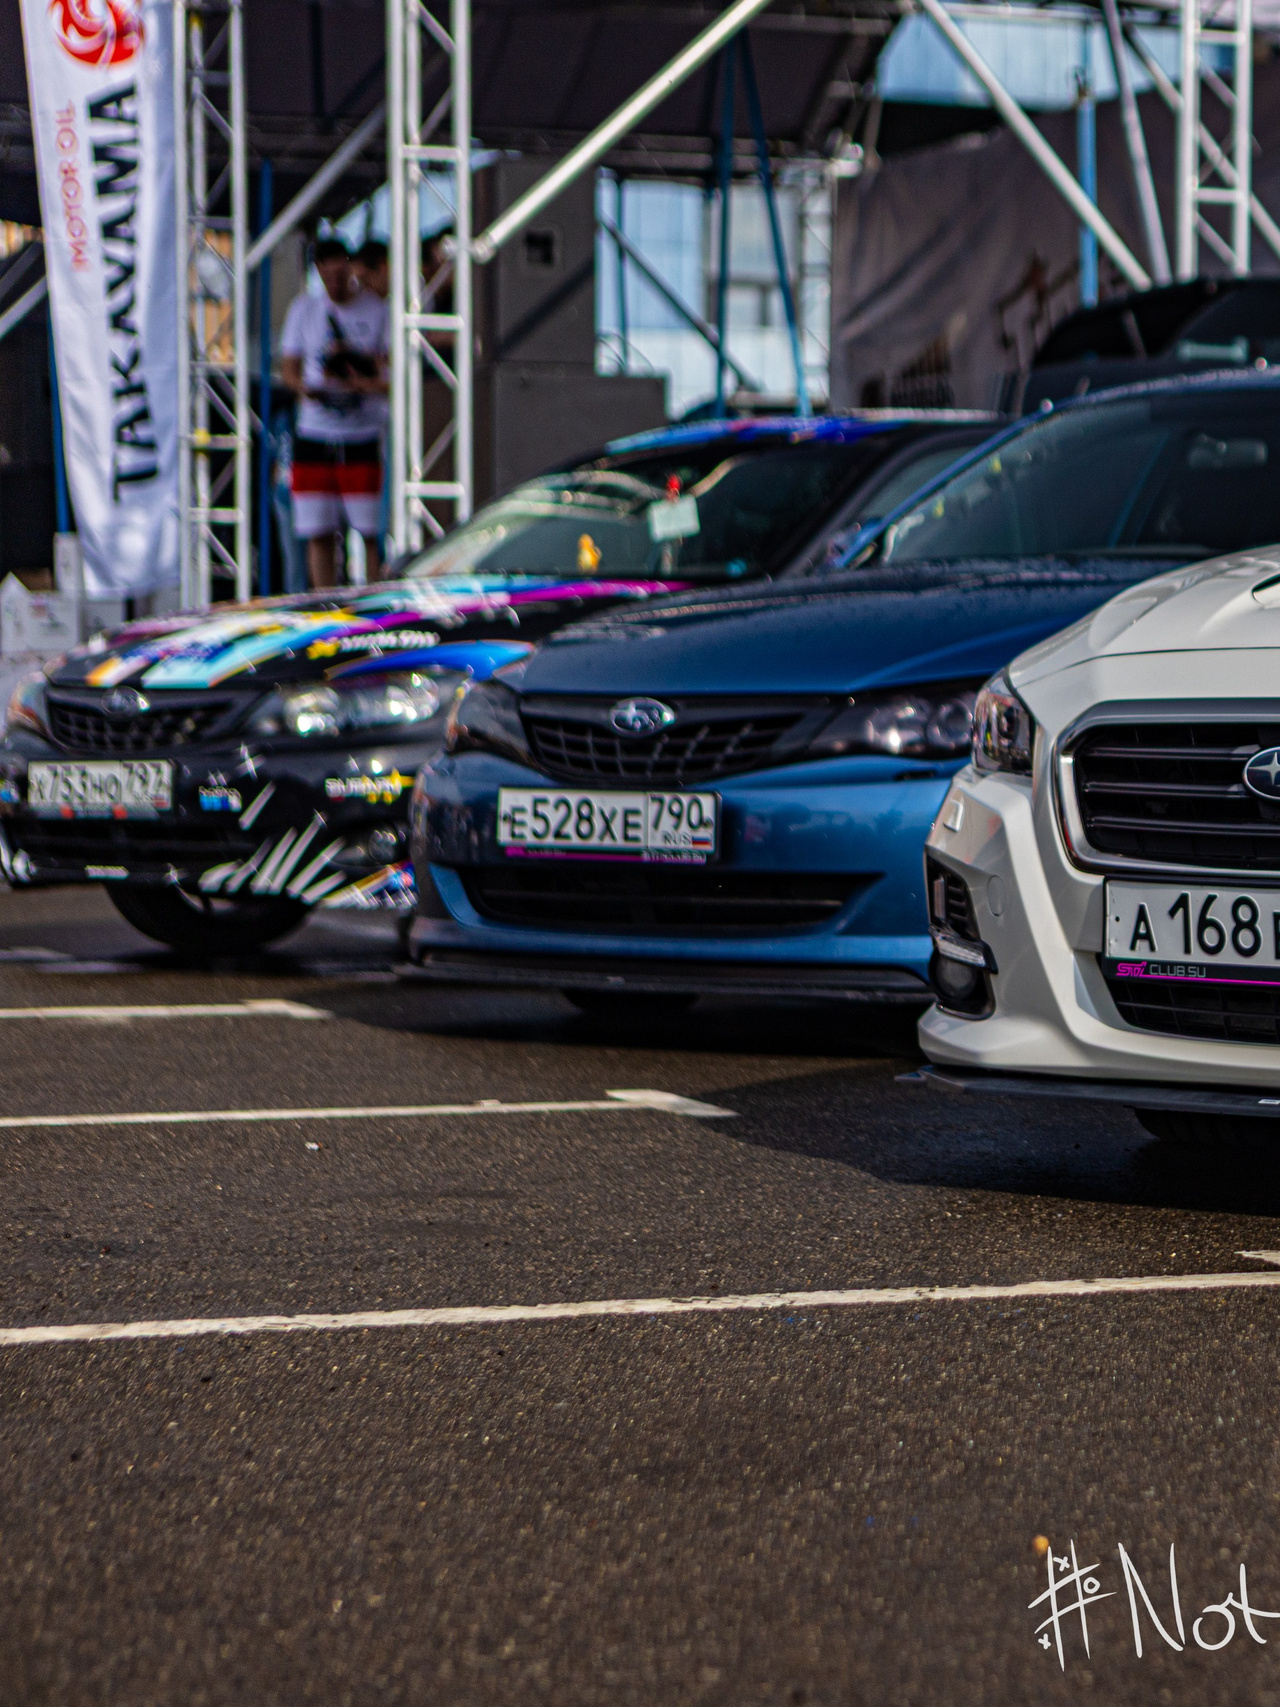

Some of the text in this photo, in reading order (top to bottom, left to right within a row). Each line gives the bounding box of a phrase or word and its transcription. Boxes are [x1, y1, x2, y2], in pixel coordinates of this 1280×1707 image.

[54, 99, 91, 272] MOTOR OIL
[86, 77, 158, 505] TAKAYAMA
[650, 795, 704, 830] 790
[1150, 964, 1207, 978] CLUB.SU
